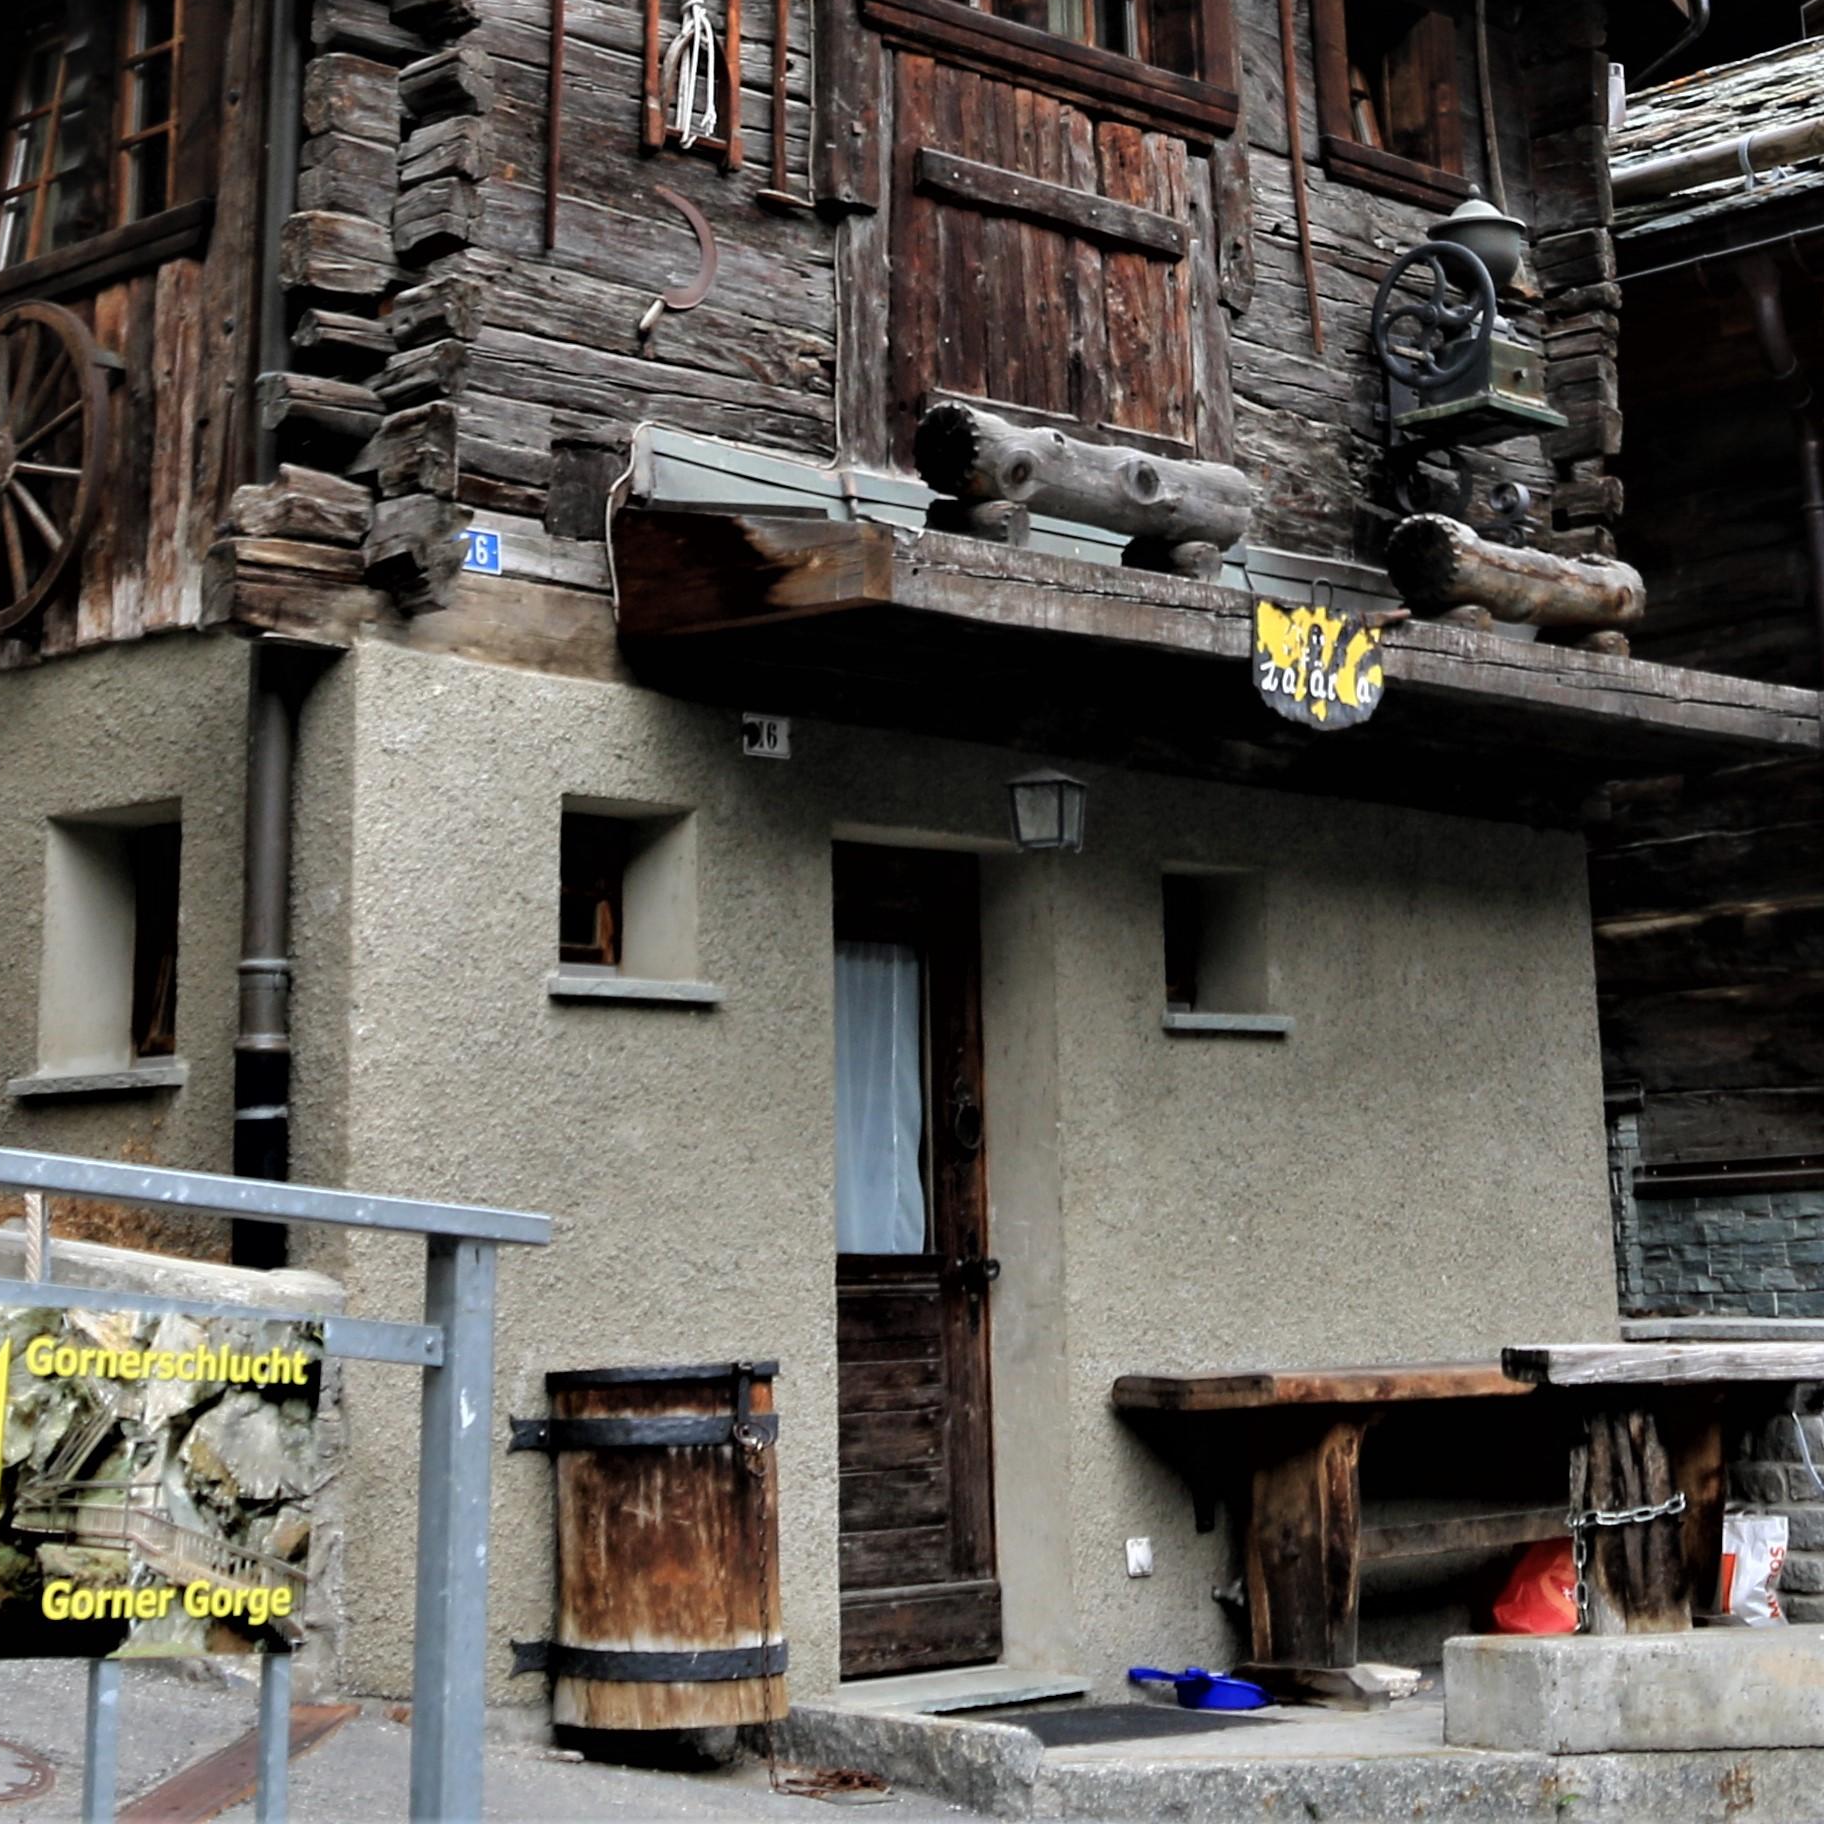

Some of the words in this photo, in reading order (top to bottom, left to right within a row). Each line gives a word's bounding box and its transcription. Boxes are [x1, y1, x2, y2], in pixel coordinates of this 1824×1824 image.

[25, 1338, 308, 1385] Gornerschlucht
[41, 1581, 176, 1621] Gorner
[183, 1580, 292, 1625] Gorge
